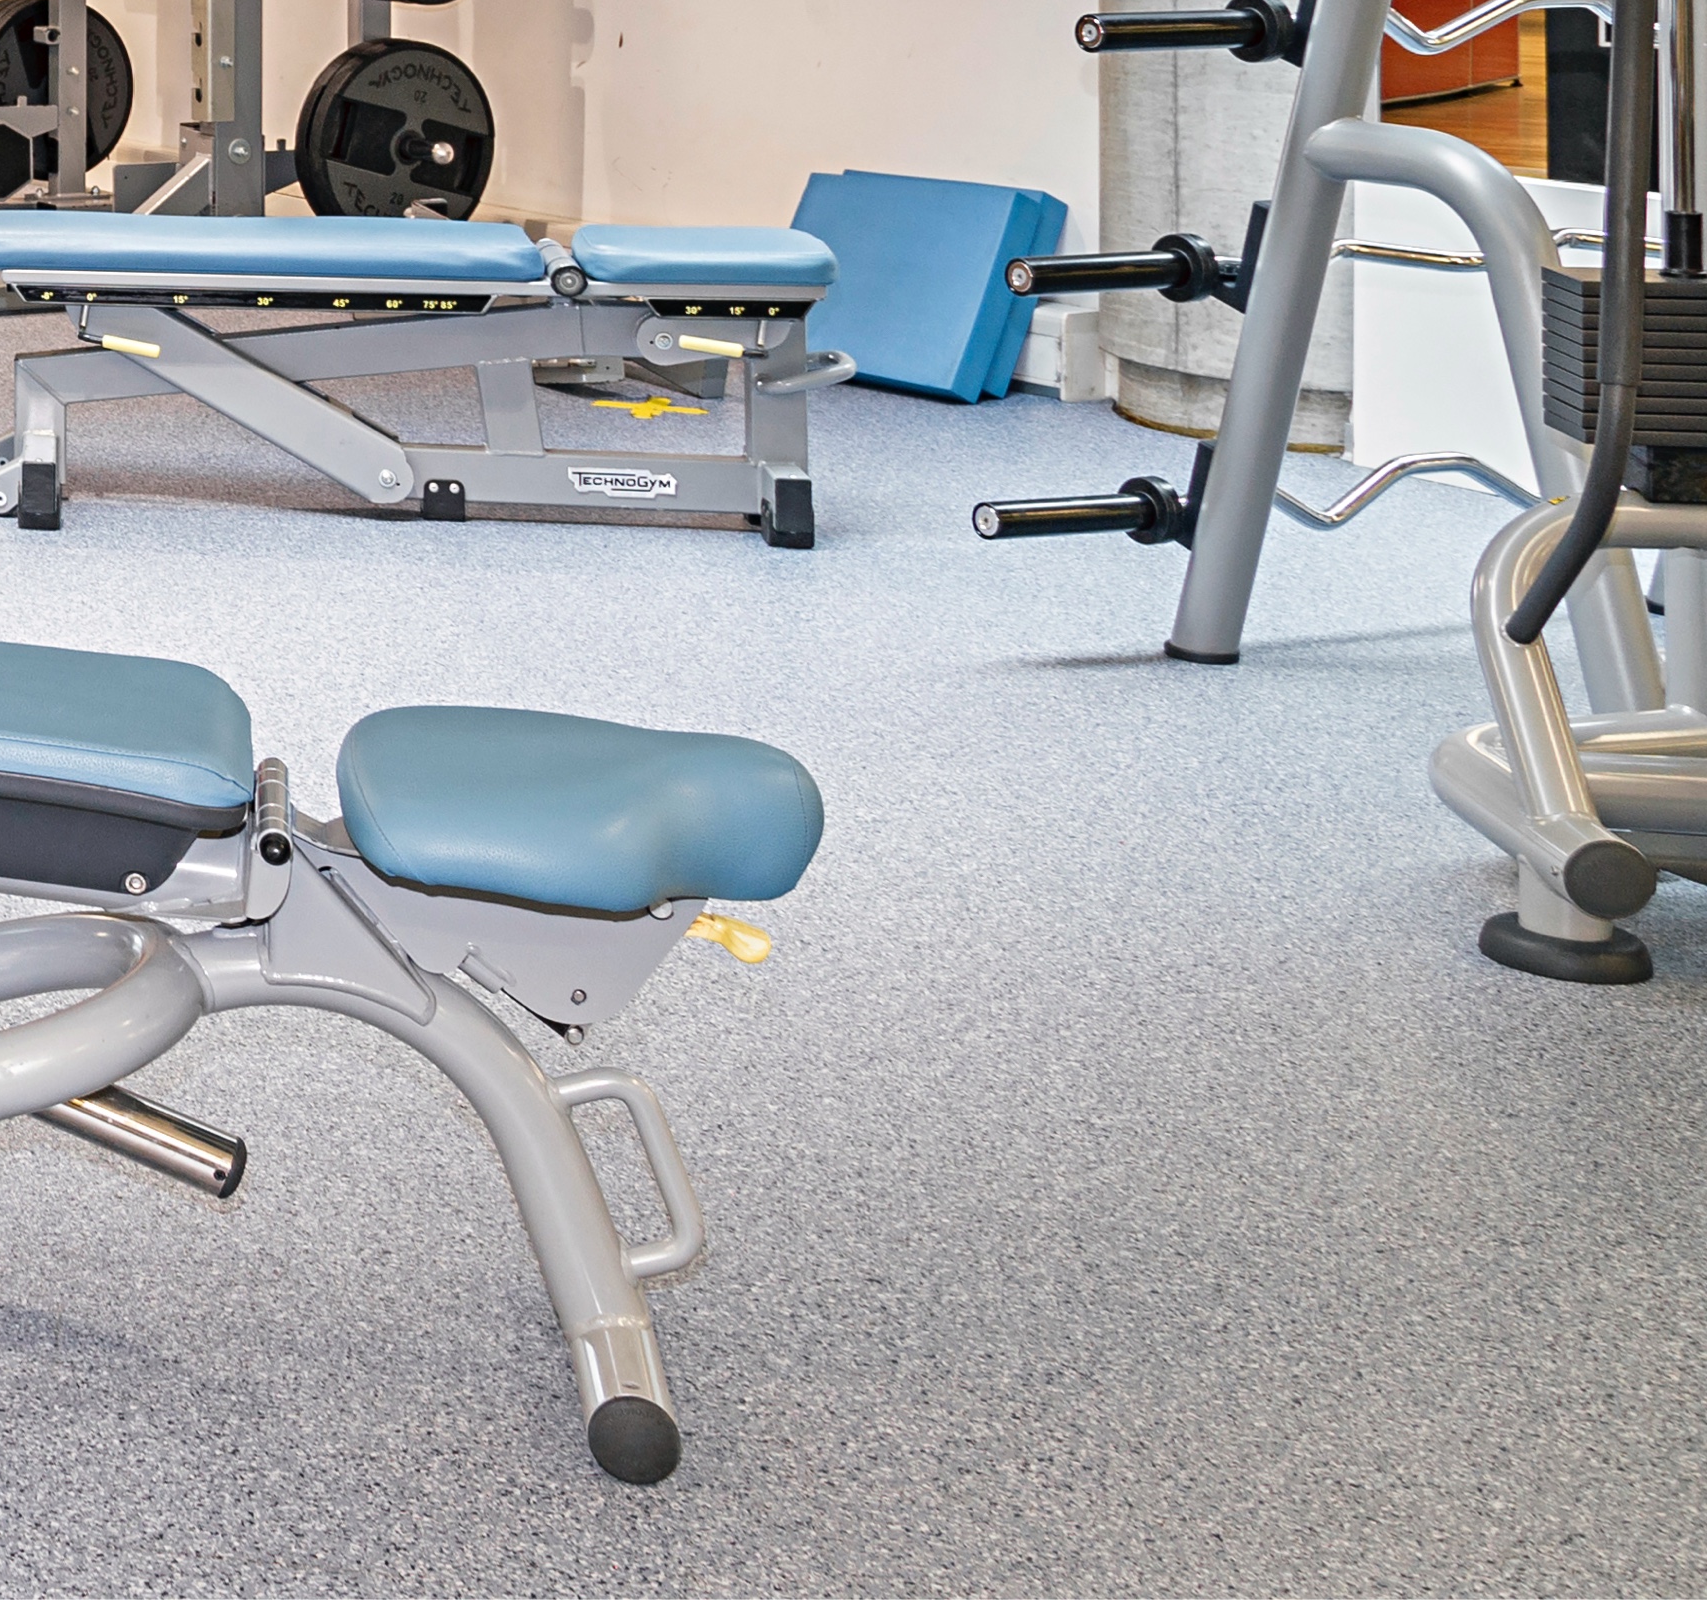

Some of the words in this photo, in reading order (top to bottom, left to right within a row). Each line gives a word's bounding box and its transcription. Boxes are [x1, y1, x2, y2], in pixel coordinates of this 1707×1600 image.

[89, 30, 119, 129] TECHNOG
[368, 63, 472, 114] TECHNOGYM
[390, 192, 404, 206] 20
[86, 293, 97, 301] 0°
[173, 295, 188, 304] 15°
[257, 297, 273, 306] 30°
[332, 299, 349, 308] 45°
[386, 300, 403, 308] 60°
[423, 300, 438, 309] 75°
[440, 301, 457, 309] 85°
[685, 306, 702, 315] 30°
[729, 306, 745, 315] 15°
[768, 307, 780, 316] 0°
[572, 472, 670, 492] TECHNOGYM
